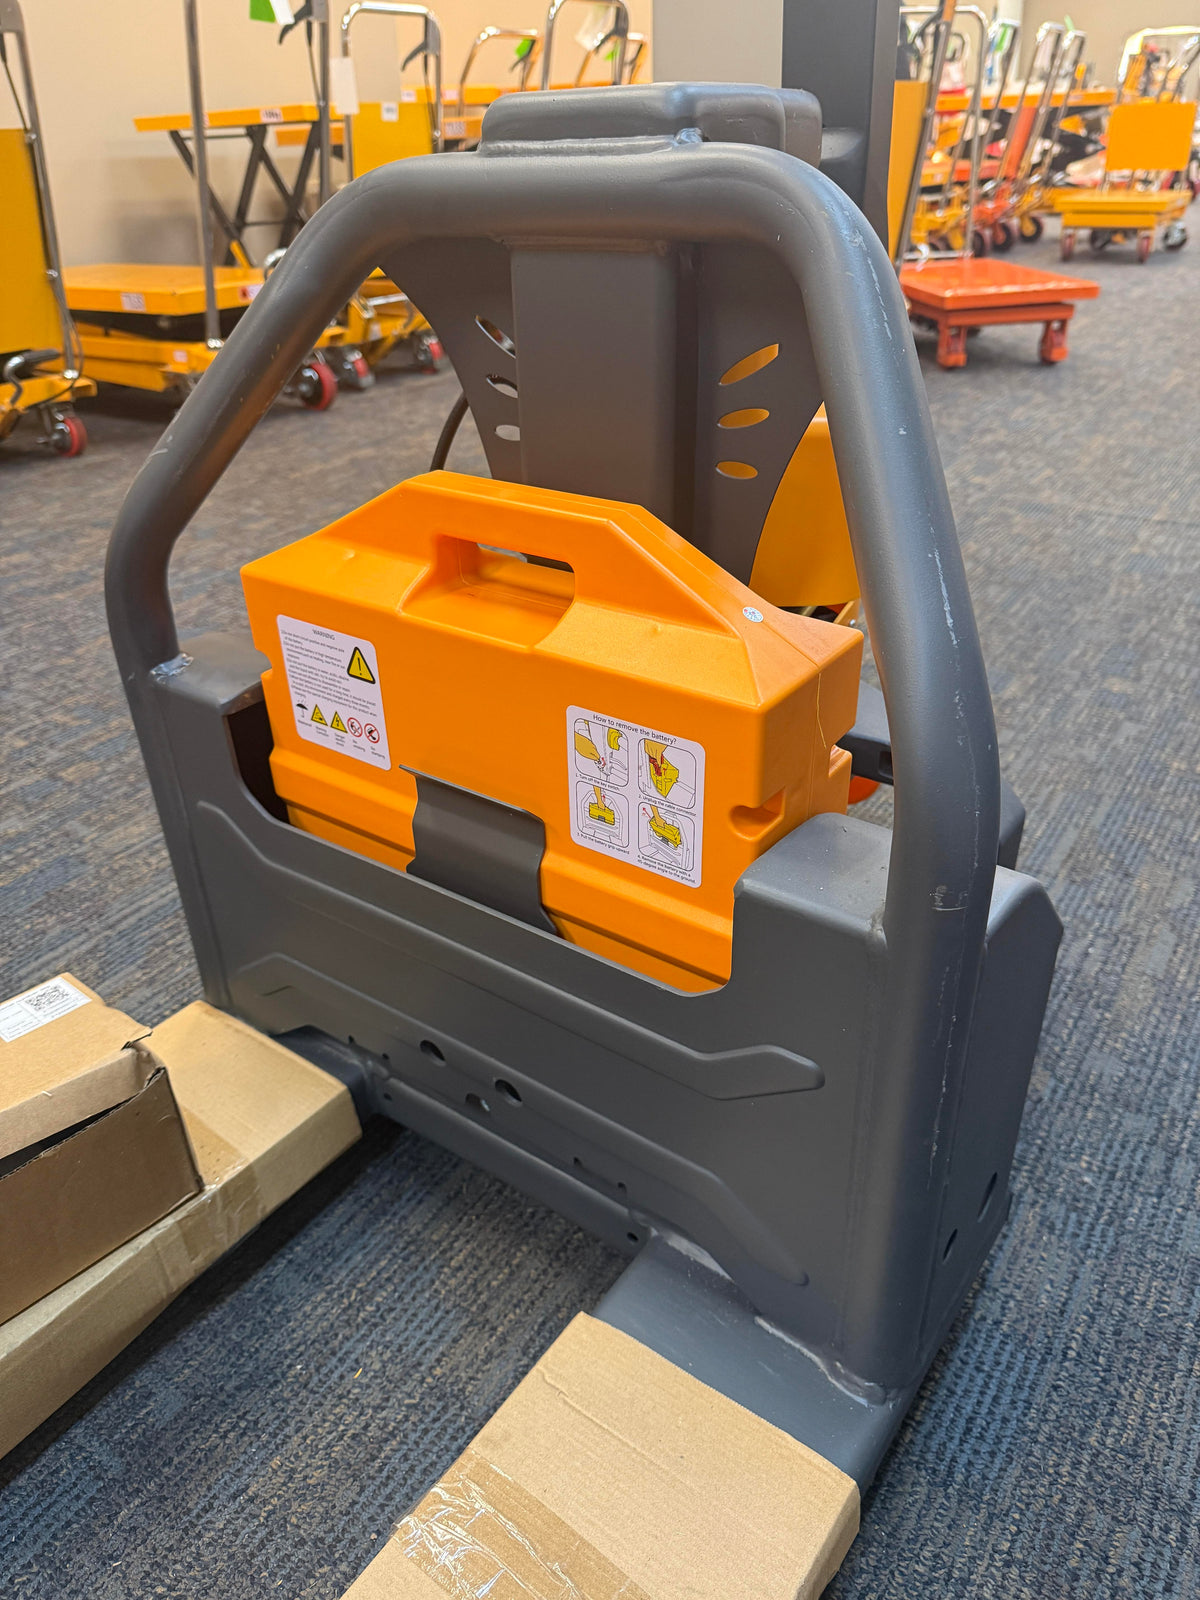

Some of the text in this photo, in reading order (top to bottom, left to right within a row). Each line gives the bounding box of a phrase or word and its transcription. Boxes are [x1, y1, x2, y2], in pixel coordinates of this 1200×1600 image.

[593, 714, 606, 723] How
[616, 722, 639, 733] remove
[652, 732, 676, 745] battery?
